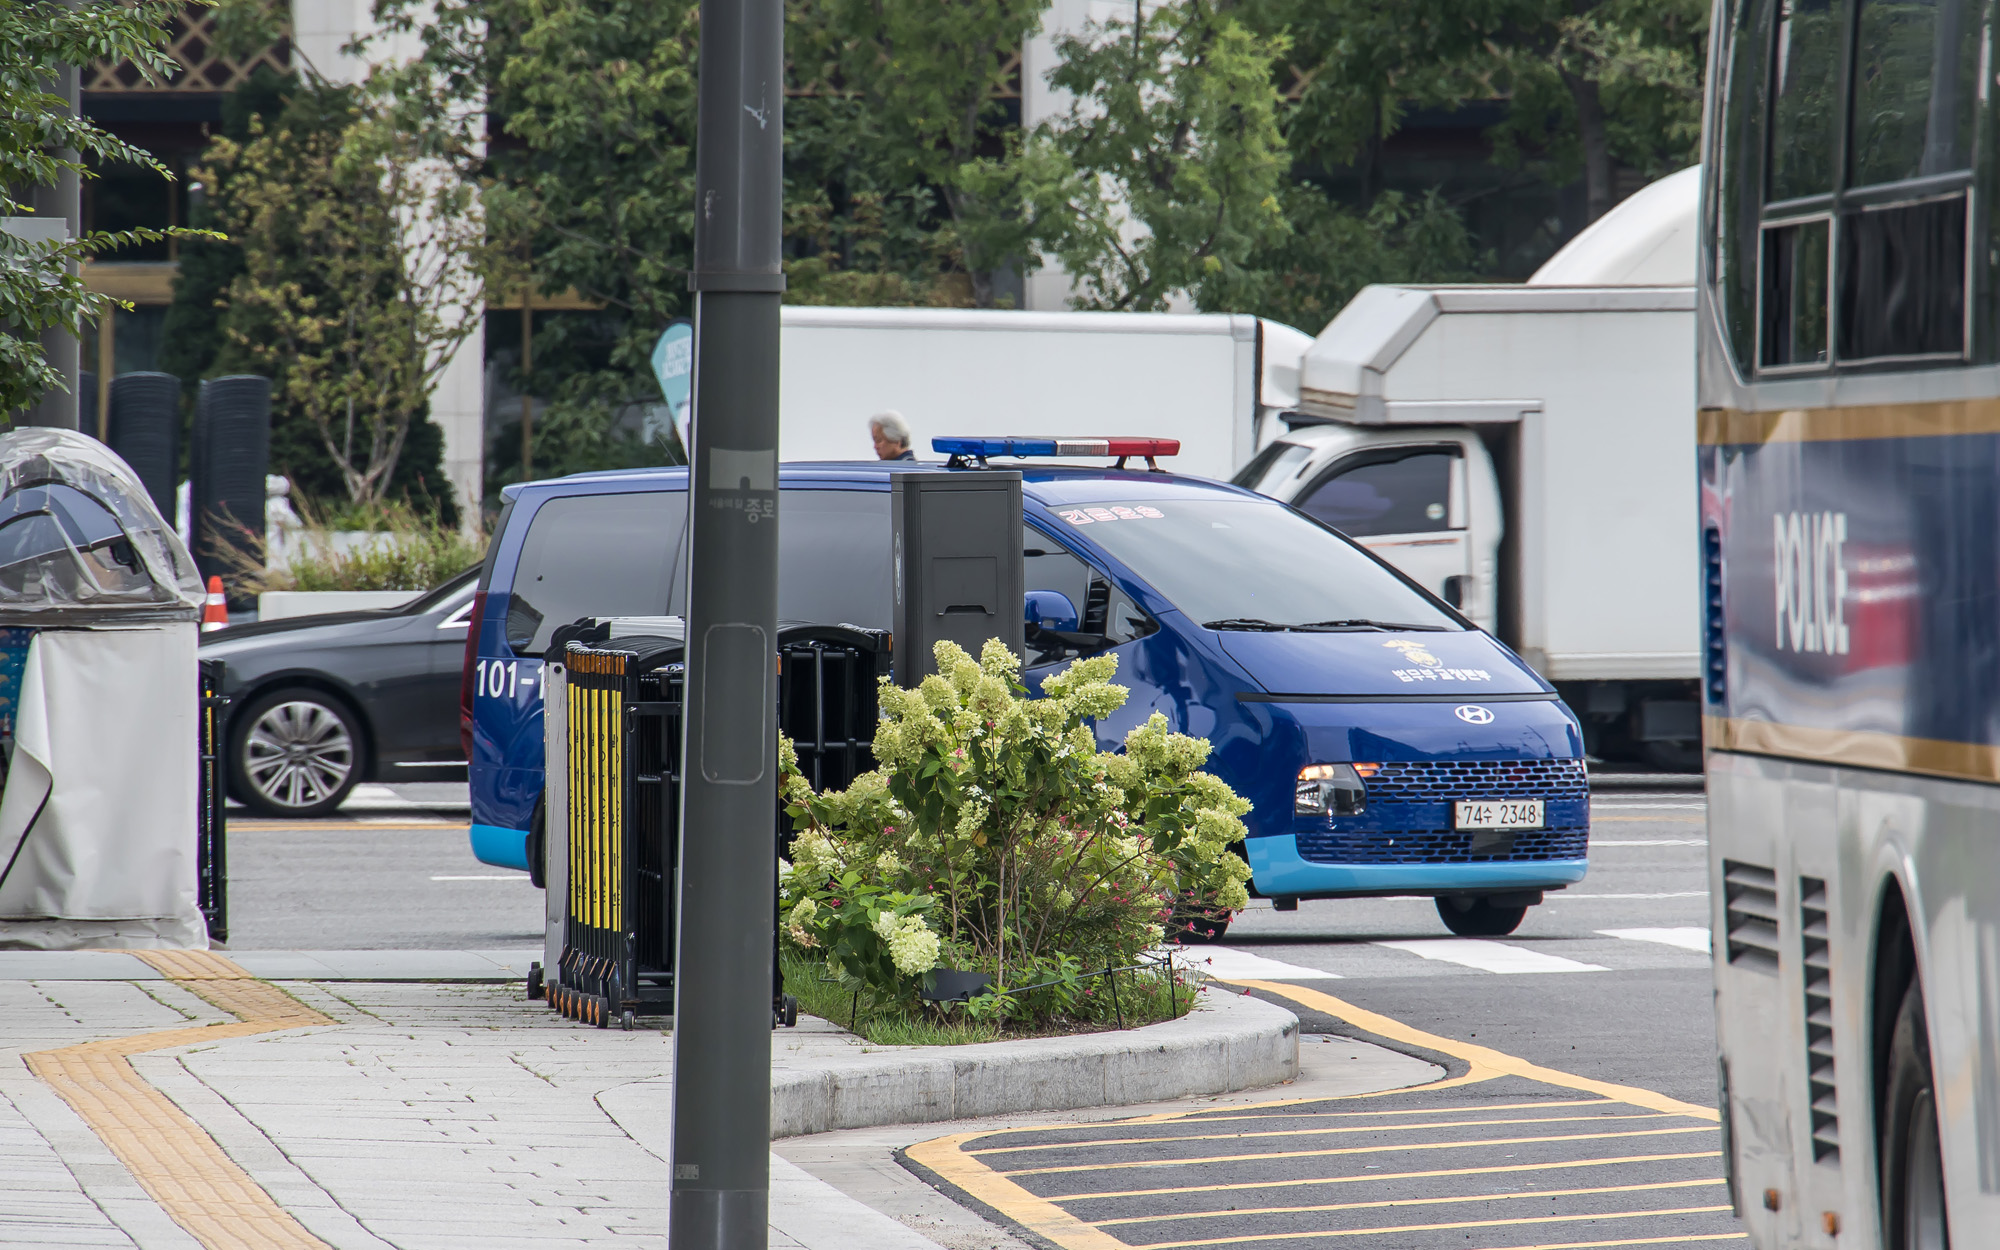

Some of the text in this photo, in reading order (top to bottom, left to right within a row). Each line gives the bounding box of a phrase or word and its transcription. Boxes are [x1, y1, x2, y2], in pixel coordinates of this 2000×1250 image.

[744, 498, 775, 523] 종로
[1773, 511, 1850, 656] POLICE
[1464, 804, 1537, 825] 74수 2348
